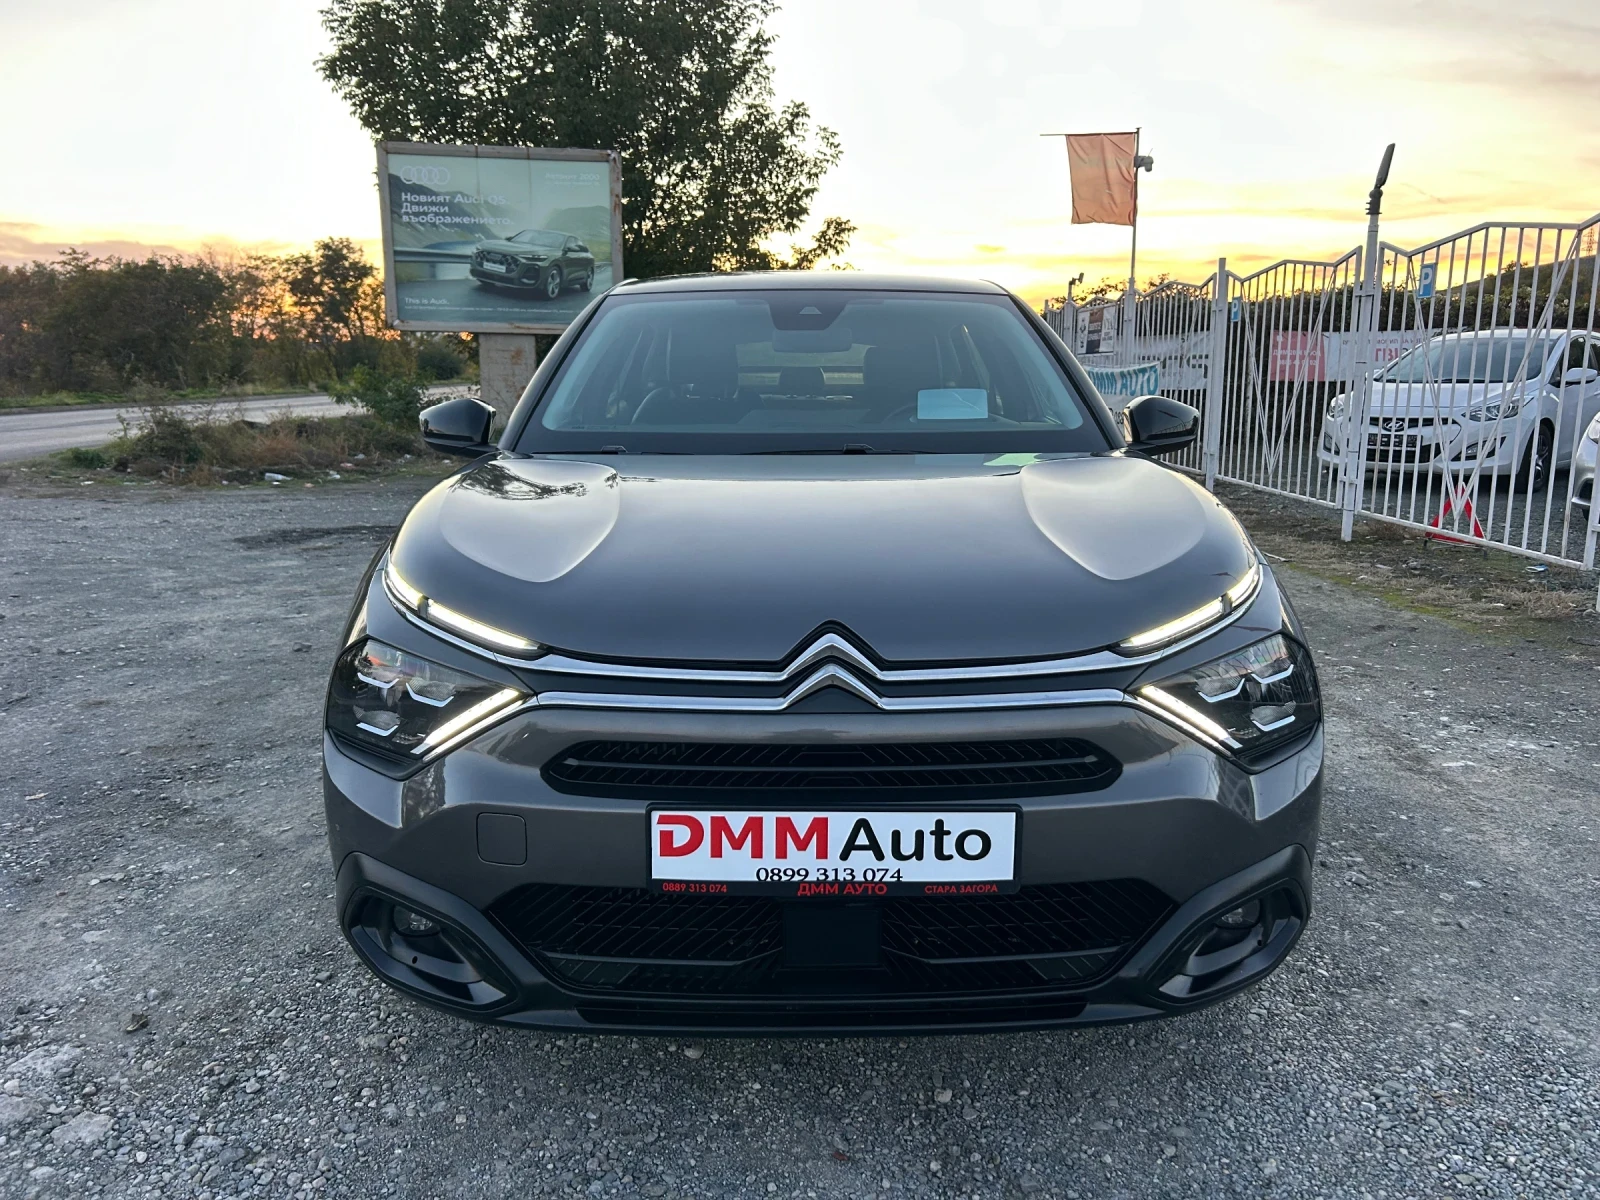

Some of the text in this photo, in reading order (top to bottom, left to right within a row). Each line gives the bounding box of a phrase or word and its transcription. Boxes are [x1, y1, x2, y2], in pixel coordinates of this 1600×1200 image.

[401, 192, 450, 203] Новият
[454, 194, 484, 204] Audi
[401, 202, 449, 213] Движи
[402, 213, 515, 225] въображението.
[1420, 267, 1433, 295] P
[405, 297, 420, 305] This
[421, 297, 429, 305] is
[1232, 299, 1239, 317] P
[1120, 365, 1159, 396] AUTO
[656, 814, 992, 862] DMM Auto
[755, 867, 904, 882] 0899 313 074
[662, 882, 728, 893] 0889 313 074
[797, 883, 887, 896] ДММ АУТО
[924, 884, 998, 895] СТАРА ЗАГОРА
